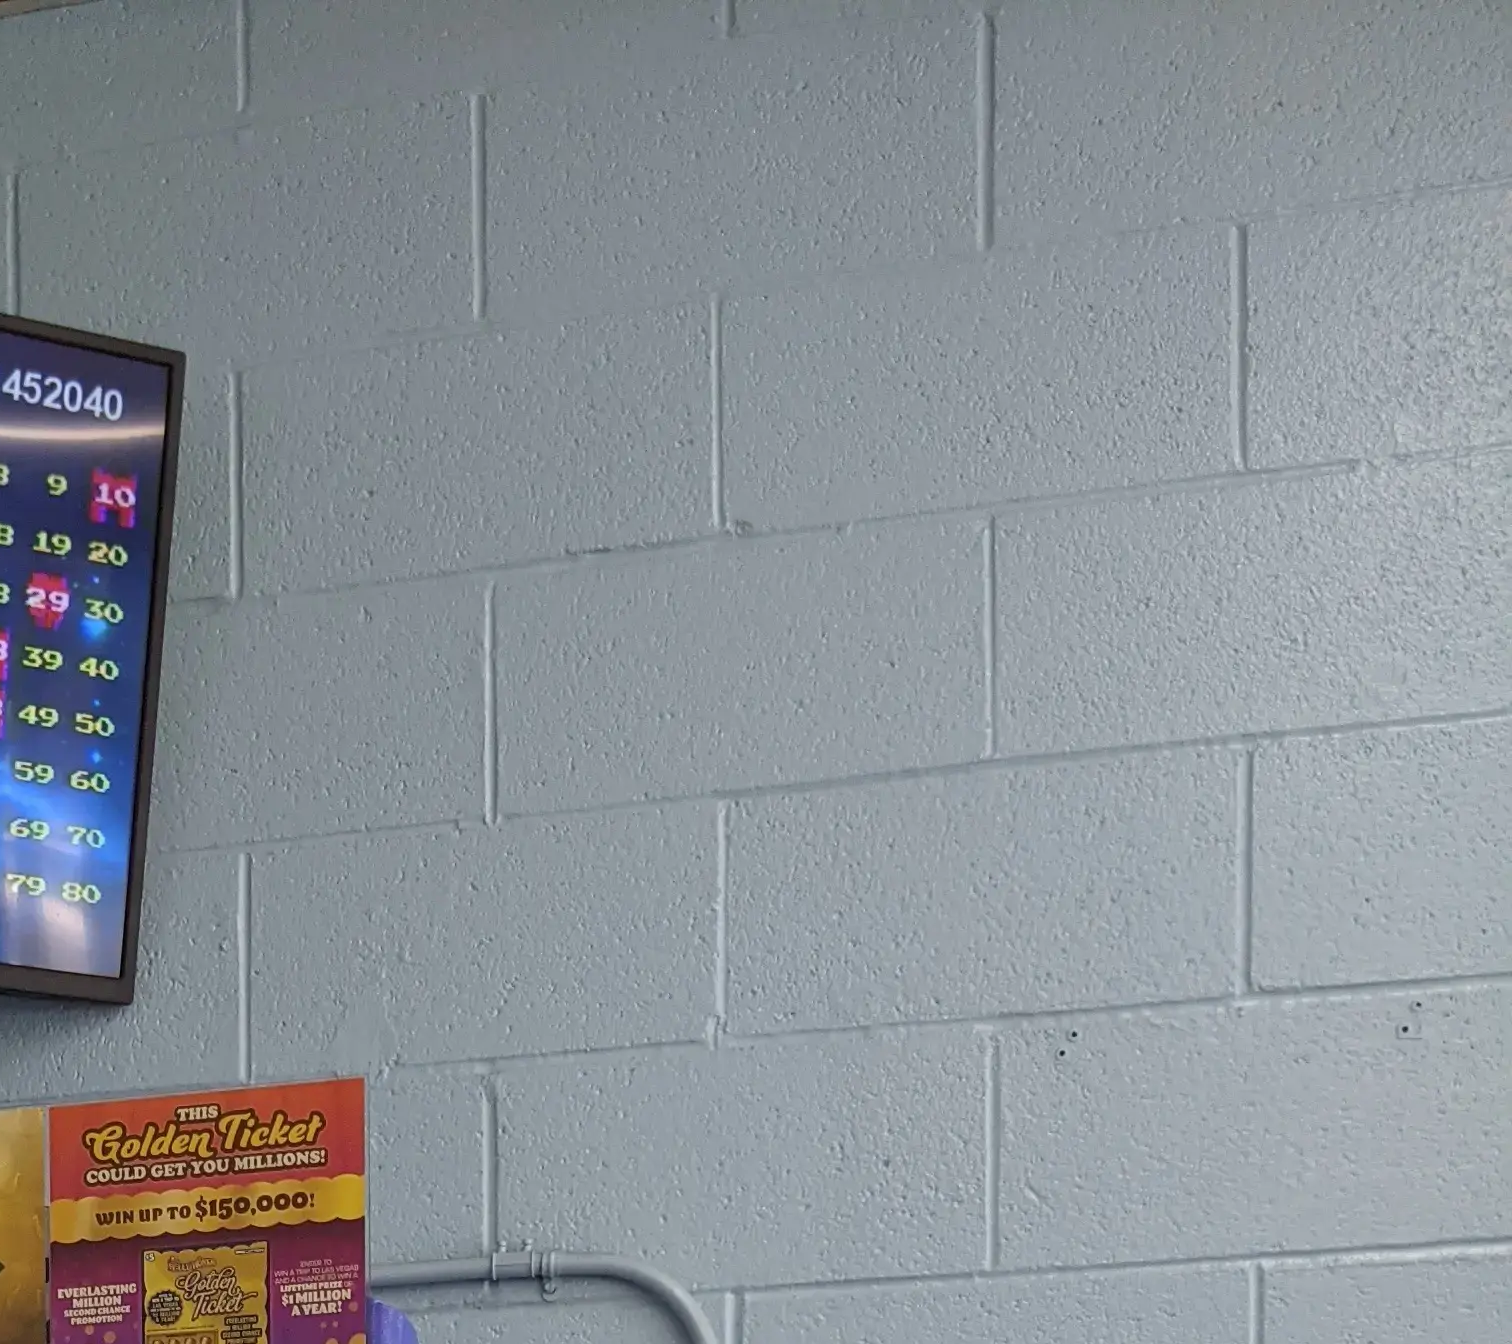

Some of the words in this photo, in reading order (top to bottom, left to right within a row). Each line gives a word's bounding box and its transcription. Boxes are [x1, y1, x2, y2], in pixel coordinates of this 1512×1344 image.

[33, 531, 72, 555] 19
[88, 542, 128, 566] 20
[177, 1105, 218, 1121] THIS
[87, 1125, 213, 1163] Golden
[219, 1113, 324, 1149] Ticket
[86, 1166, 146, 1184] COULD
[151, 1162, 187, 1177] GET
[190, 1158, 229, 1173] YOU
[234, 1151, 325, 1170] MILLIONS!
[96, 1212, 134, 1226] WIN
[140, 1208, 163, 1222] UP
[169, 1206, 191, 1220] TO
[195, 1193, 315, 1222] $150,000!
[58, 1284, 136, 1299] EVERLASTING
[72, 1296, 122, 1308] MILLION
